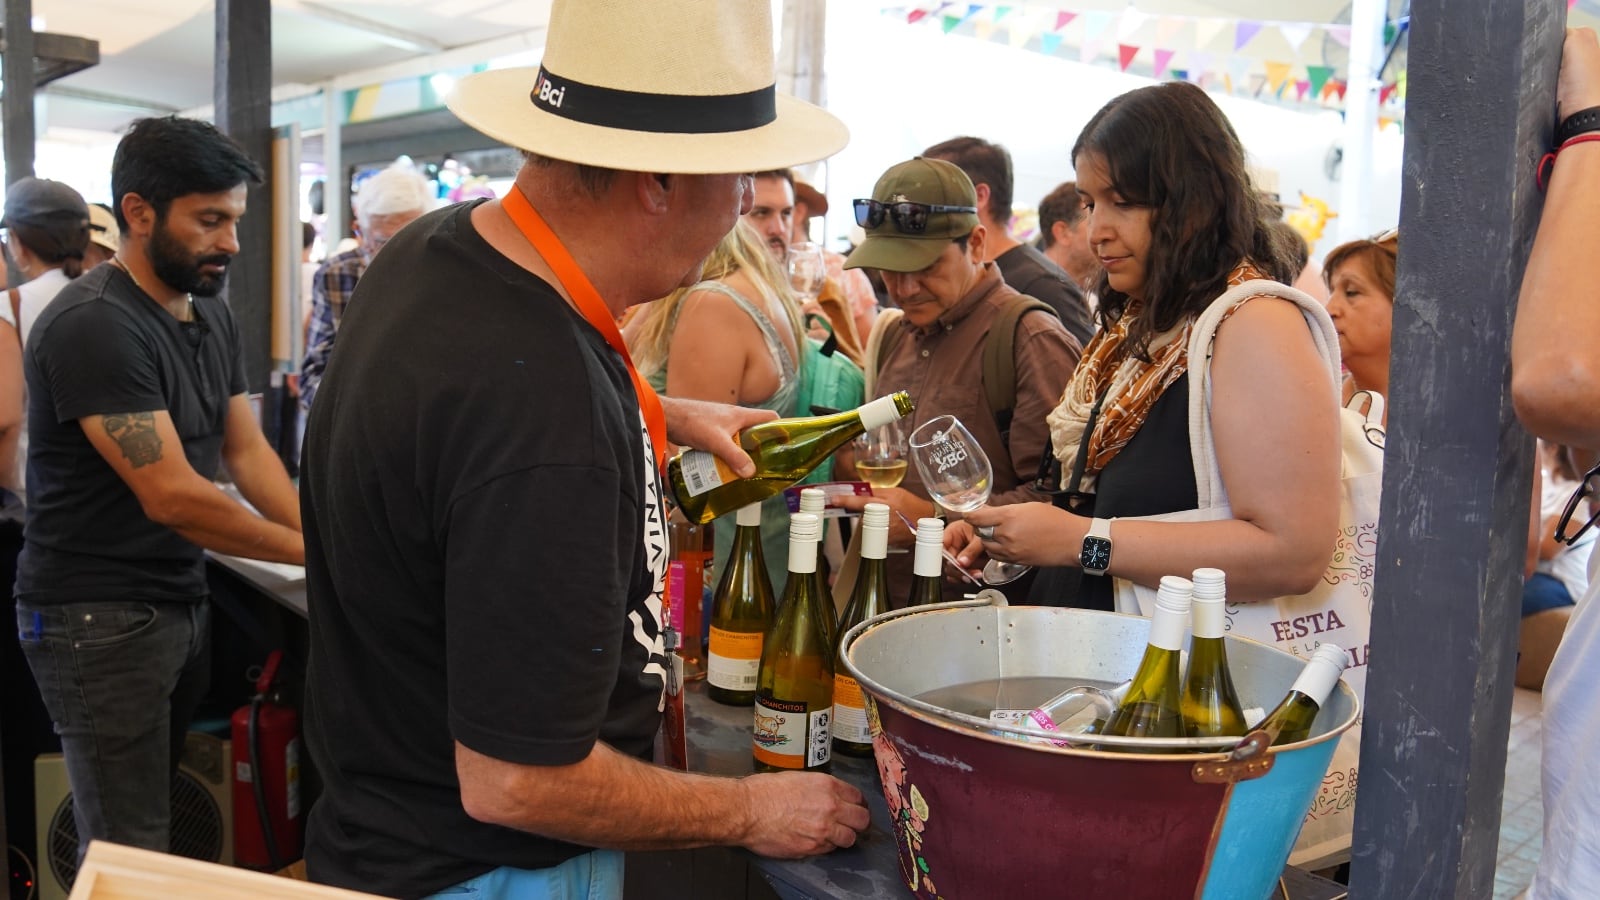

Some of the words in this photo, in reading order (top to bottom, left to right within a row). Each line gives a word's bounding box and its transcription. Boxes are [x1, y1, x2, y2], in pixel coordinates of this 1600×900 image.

[539, 79, 566, 108] Bci
[1304, 640, 1321, 652] LA
[761, 698, 804, 712] CHANCHITOS
